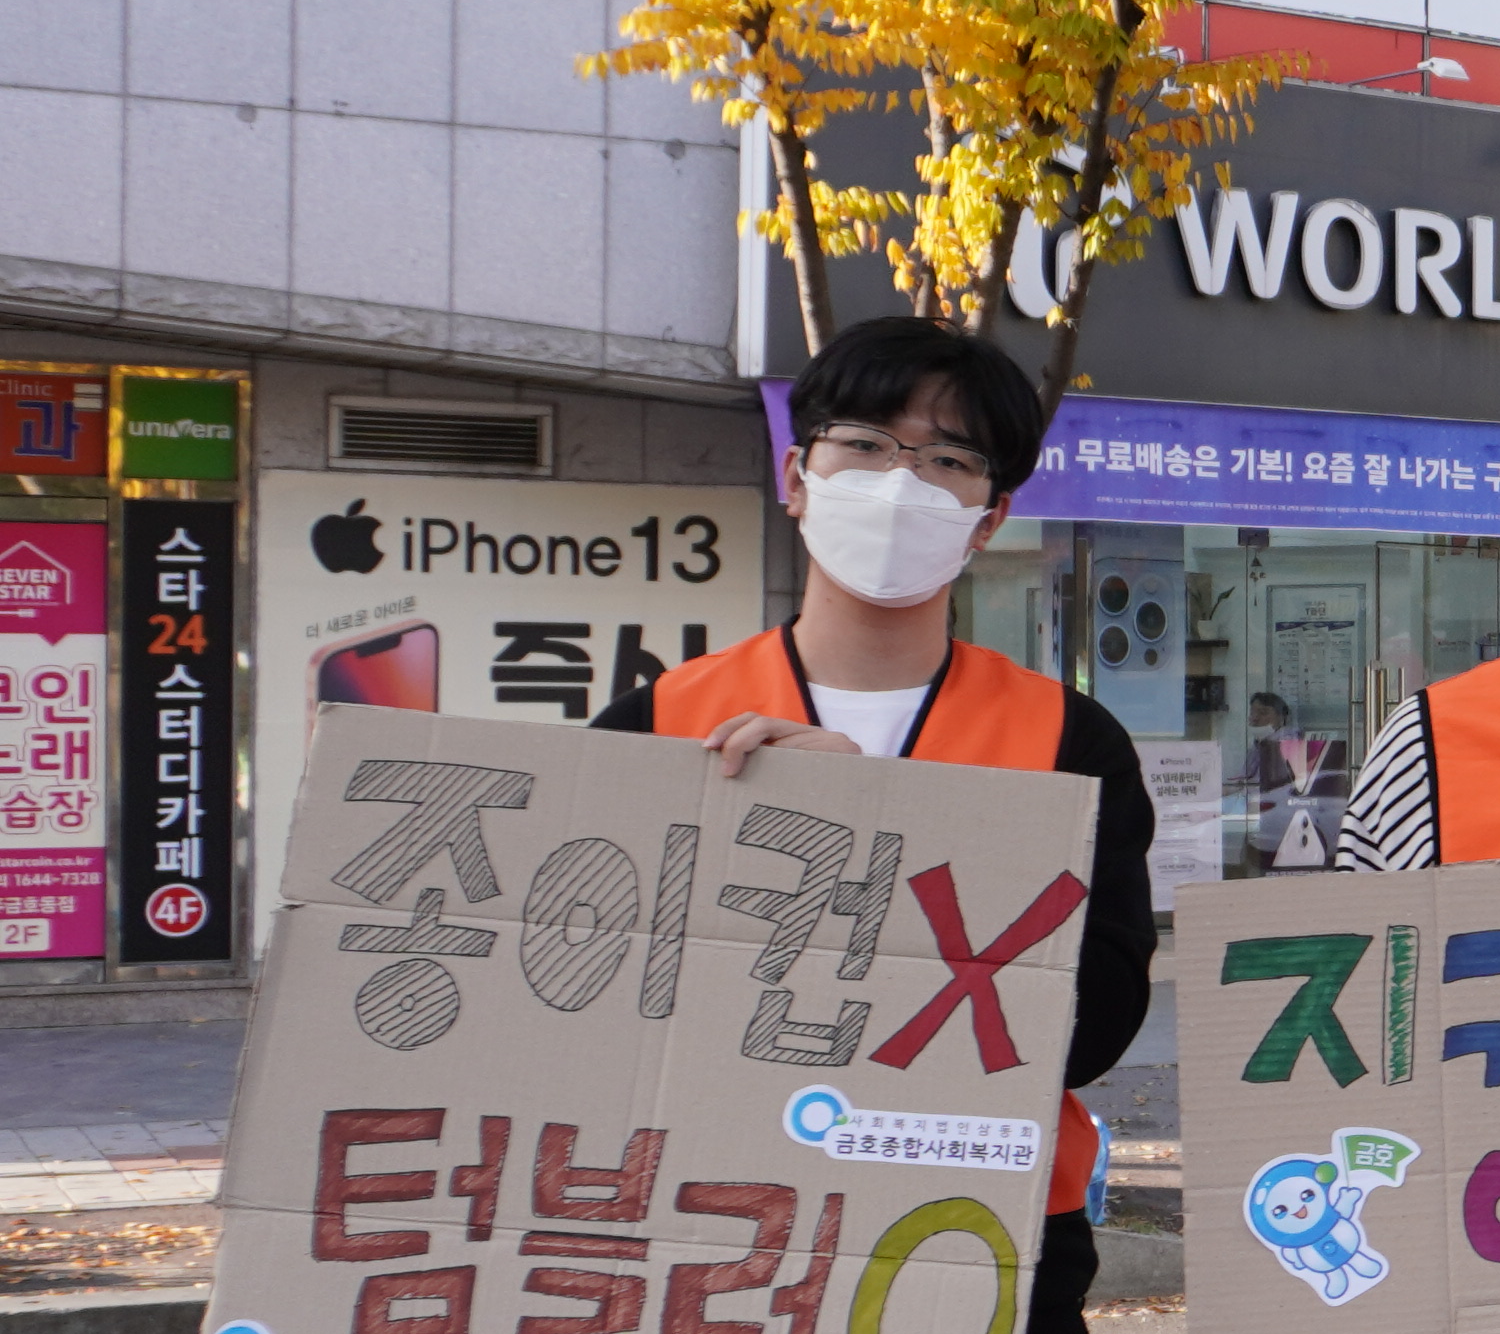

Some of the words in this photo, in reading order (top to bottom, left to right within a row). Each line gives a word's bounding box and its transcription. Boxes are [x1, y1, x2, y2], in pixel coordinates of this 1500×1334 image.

[128, 418, 232, 440] univera
[1075, 438, 1221, 481] 무료배송은
[1230, 447, 1293, 483] 기본!
[1302, 451, 1355, 485] 요즘
[1363, 452, 1390, 488] 잘
[1399, 456, 1477, 492] 나가는
[402, 517, 622, 576] iPhone
[631, 514, 722, 584] 13
[306, 625, 321, 641] 더
[326, 608, 368, 634] 새로운
[373, 595, 418, 621] 아이폰
[155, 896, 201, 925] 4F
[330, 758, 903, 1068] 종이컵
[5, 924, 41, 945] 2F
[834, 1130, 1036, 1168] 금호종합사회복지관
[1354, 1141, 1395, 1170] 금호
